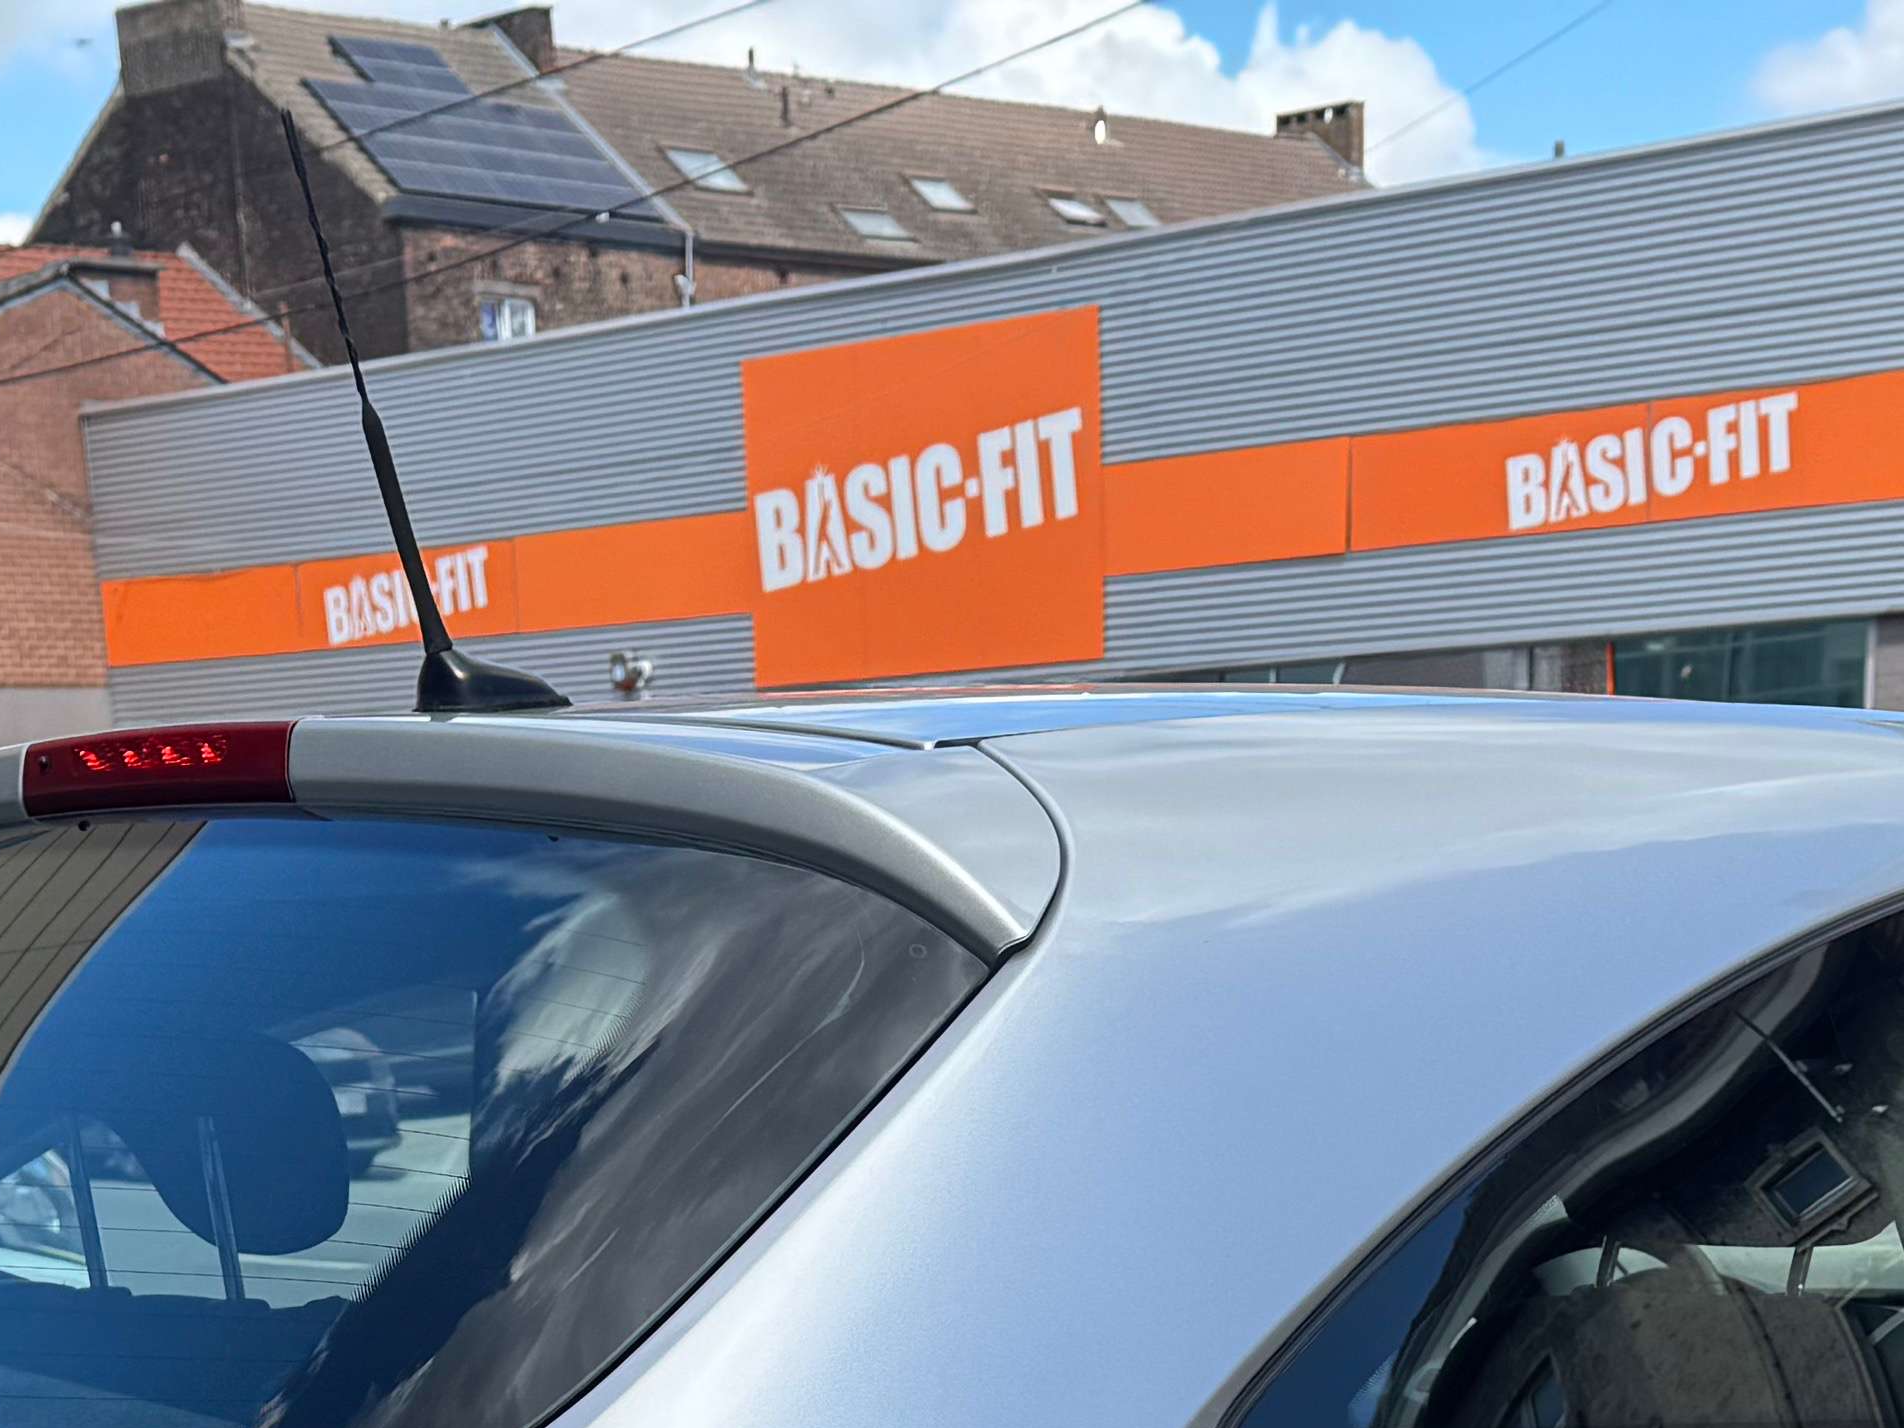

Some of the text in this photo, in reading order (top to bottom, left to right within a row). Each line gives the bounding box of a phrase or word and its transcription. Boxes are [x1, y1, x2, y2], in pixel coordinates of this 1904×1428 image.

[753, 406, 1083, 593] BASIC-FIT
[1504, 391, 1798, 531] BASIC-FIT
[323, 545, 489, 647] BASI-FIT
